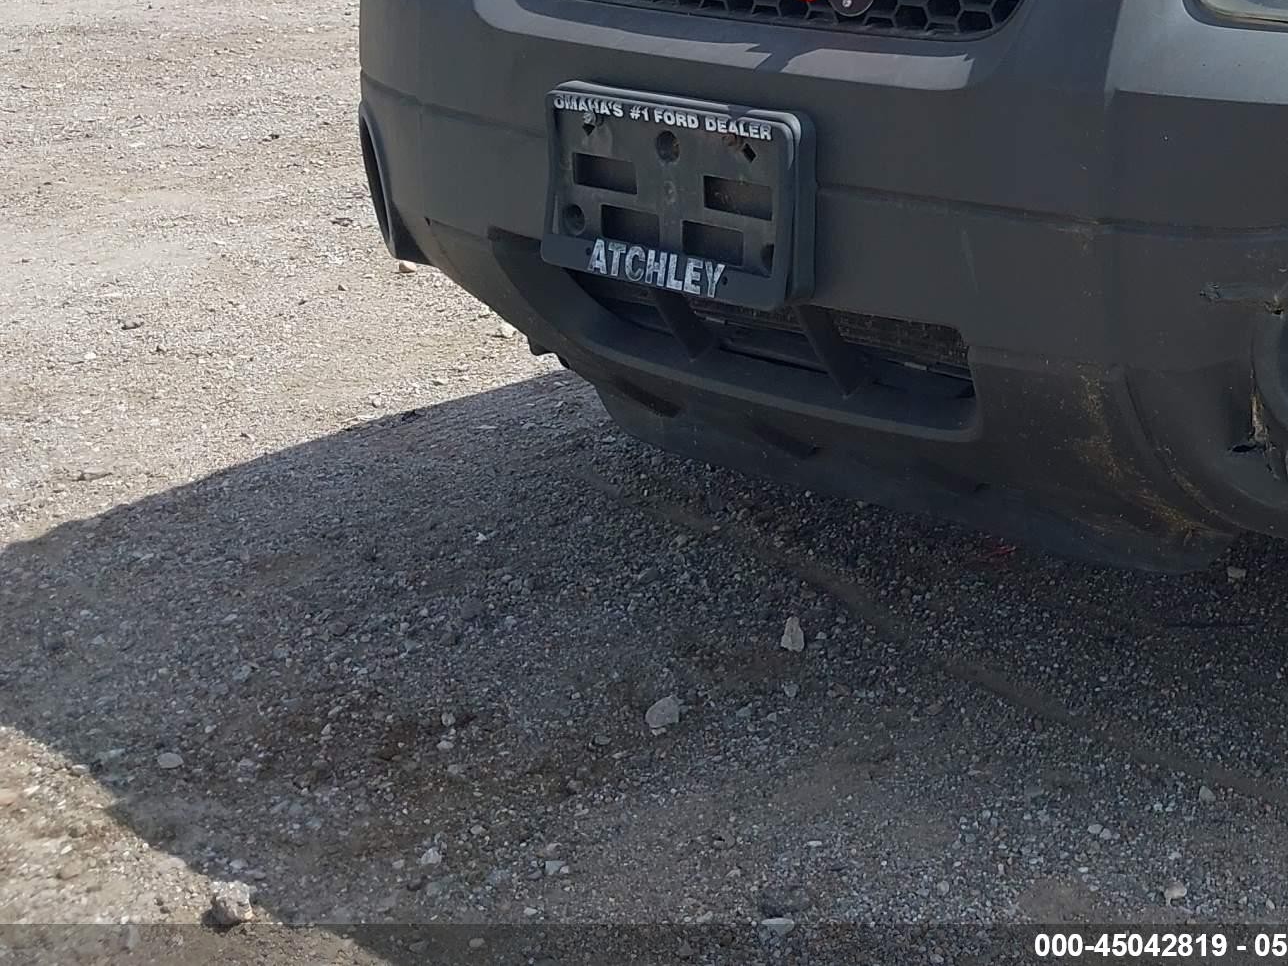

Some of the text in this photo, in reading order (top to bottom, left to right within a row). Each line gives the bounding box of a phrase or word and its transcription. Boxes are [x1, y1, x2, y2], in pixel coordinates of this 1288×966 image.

[553, 94, 773, 141] OMAHA'S #1 FORD DEALER
[586, 238, 726, 299] ATCHLEY
